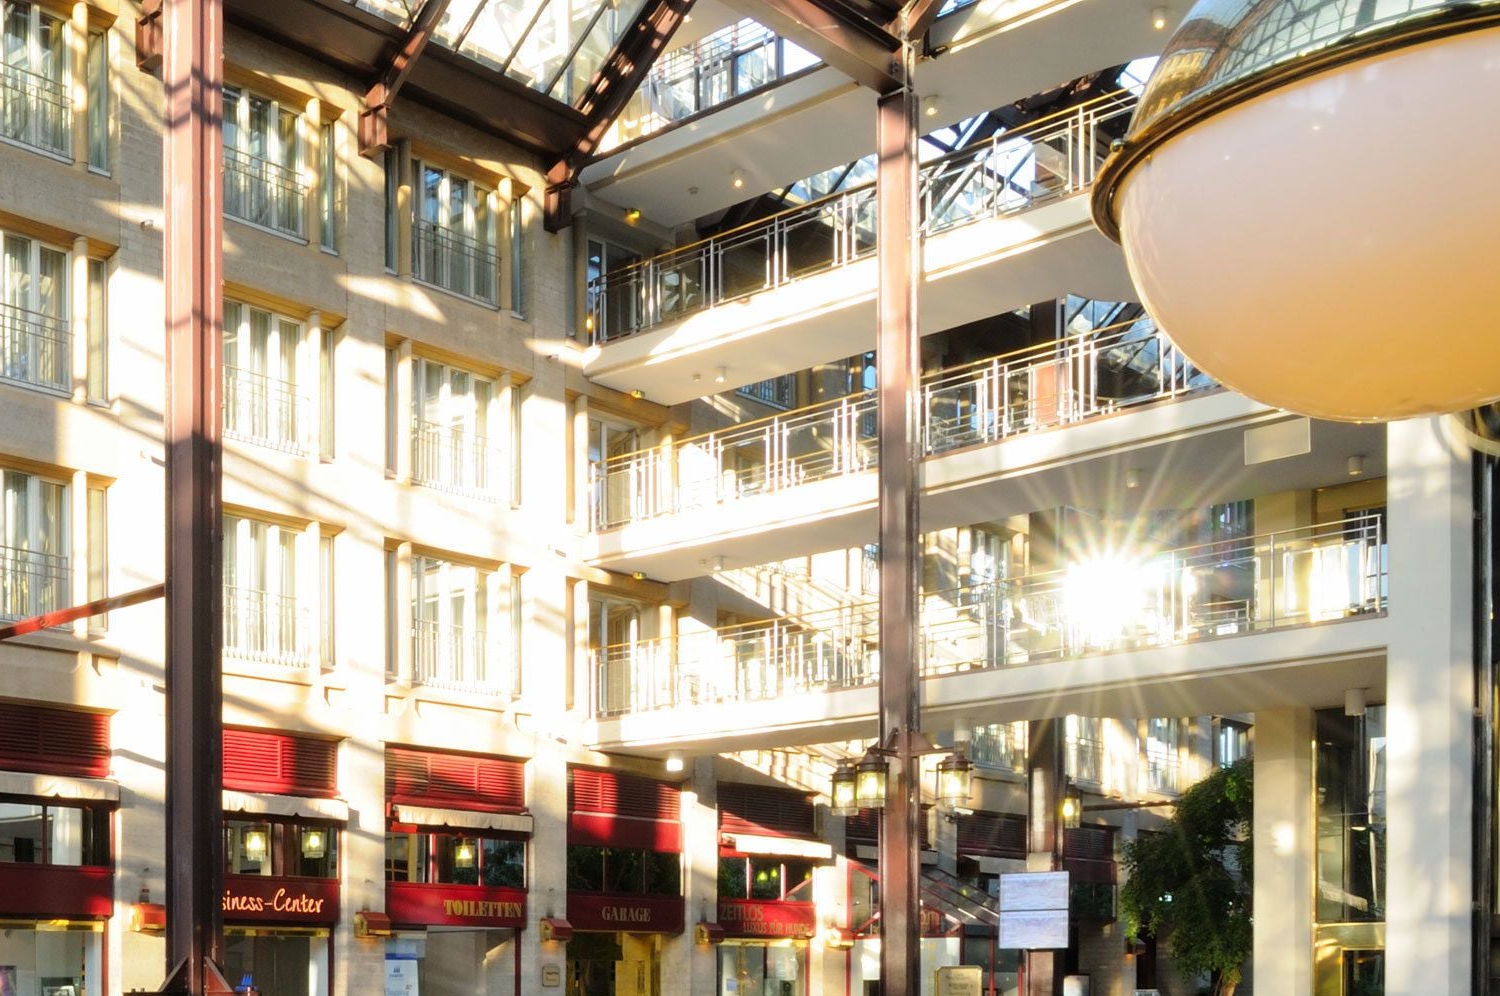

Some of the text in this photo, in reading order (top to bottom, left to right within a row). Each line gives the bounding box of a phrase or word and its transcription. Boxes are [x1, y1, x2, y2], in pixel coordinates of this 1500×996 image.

[443, 899, 523, 918] TOILETTEN
[601, 906, 651, 922] GARAGE
[721, 903, 765, 922] ZEITLOS
